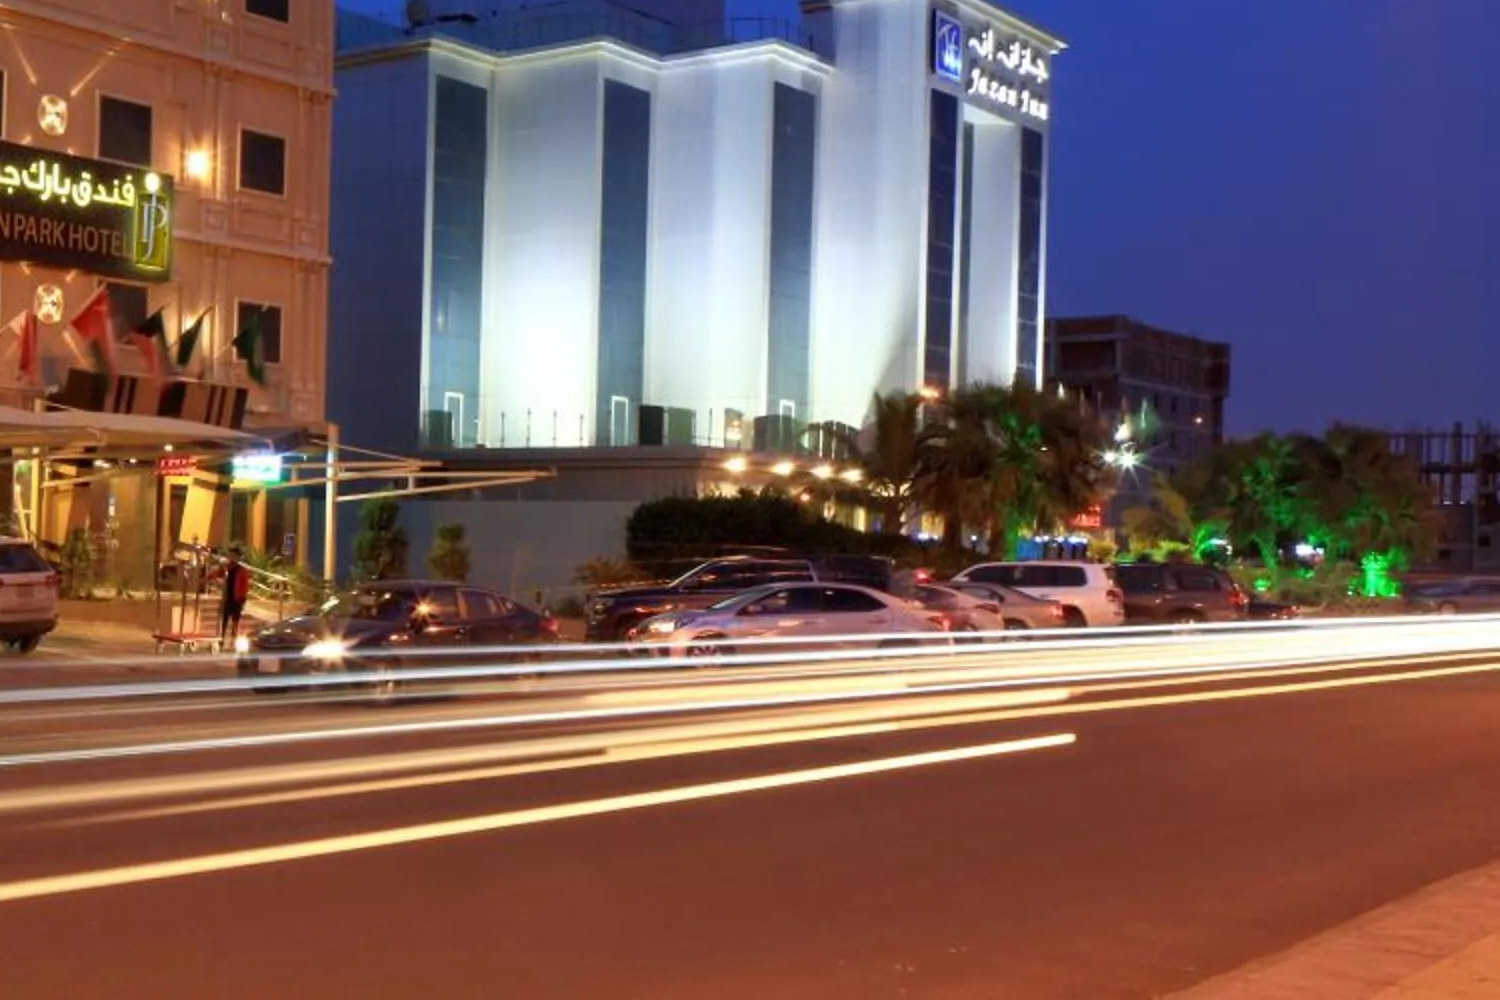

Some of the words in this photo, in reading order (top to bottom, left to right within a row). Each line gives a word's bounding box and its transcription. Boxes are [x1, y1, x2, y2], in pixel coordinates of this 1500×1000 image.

[21, 159, 71, 203] بارك
[71, 171, 135, 207] فندق
[14, 214, 65, 248] PARK
[69, 222, 134, 259] HOTEL
